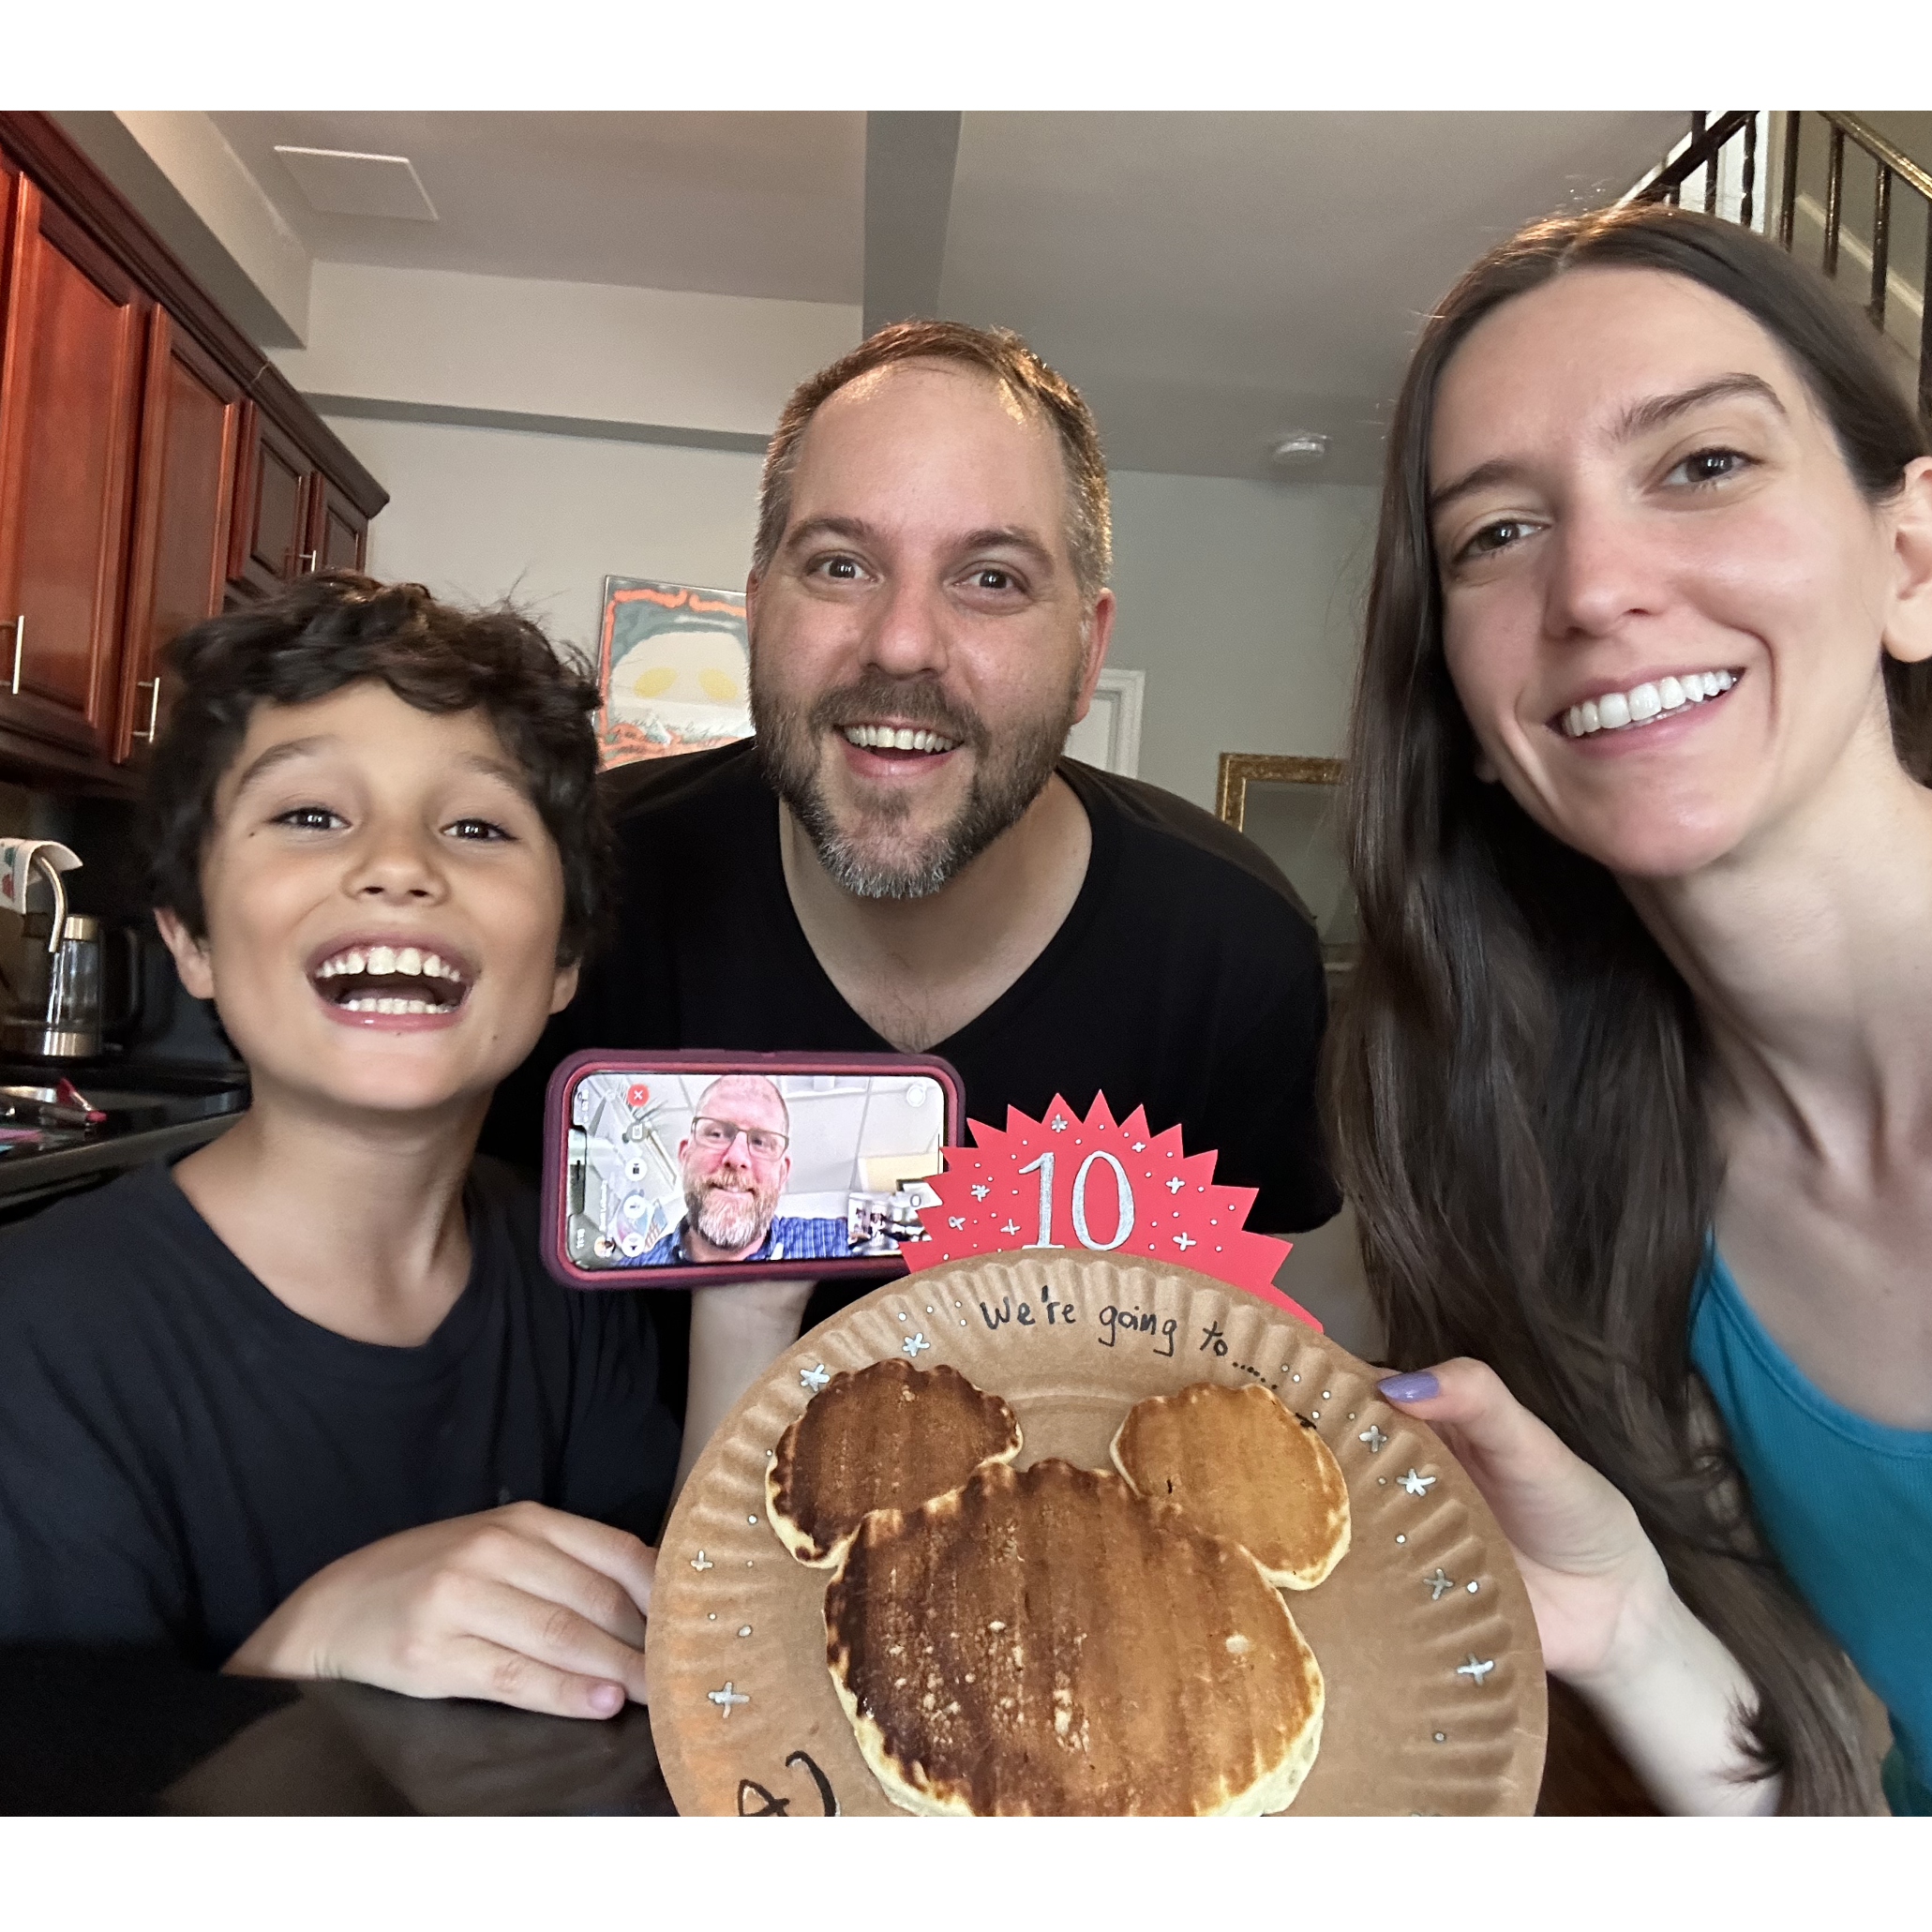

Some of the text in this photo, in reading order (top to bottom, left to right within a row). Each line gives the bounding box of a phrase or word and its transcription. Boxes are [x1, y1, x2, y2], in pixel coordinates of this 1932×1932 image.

[1018, 1149, 1135, 1251] 10
[979, 1285, 1077, 1330] We're
[1098, 1305, 1177, 1357] going
